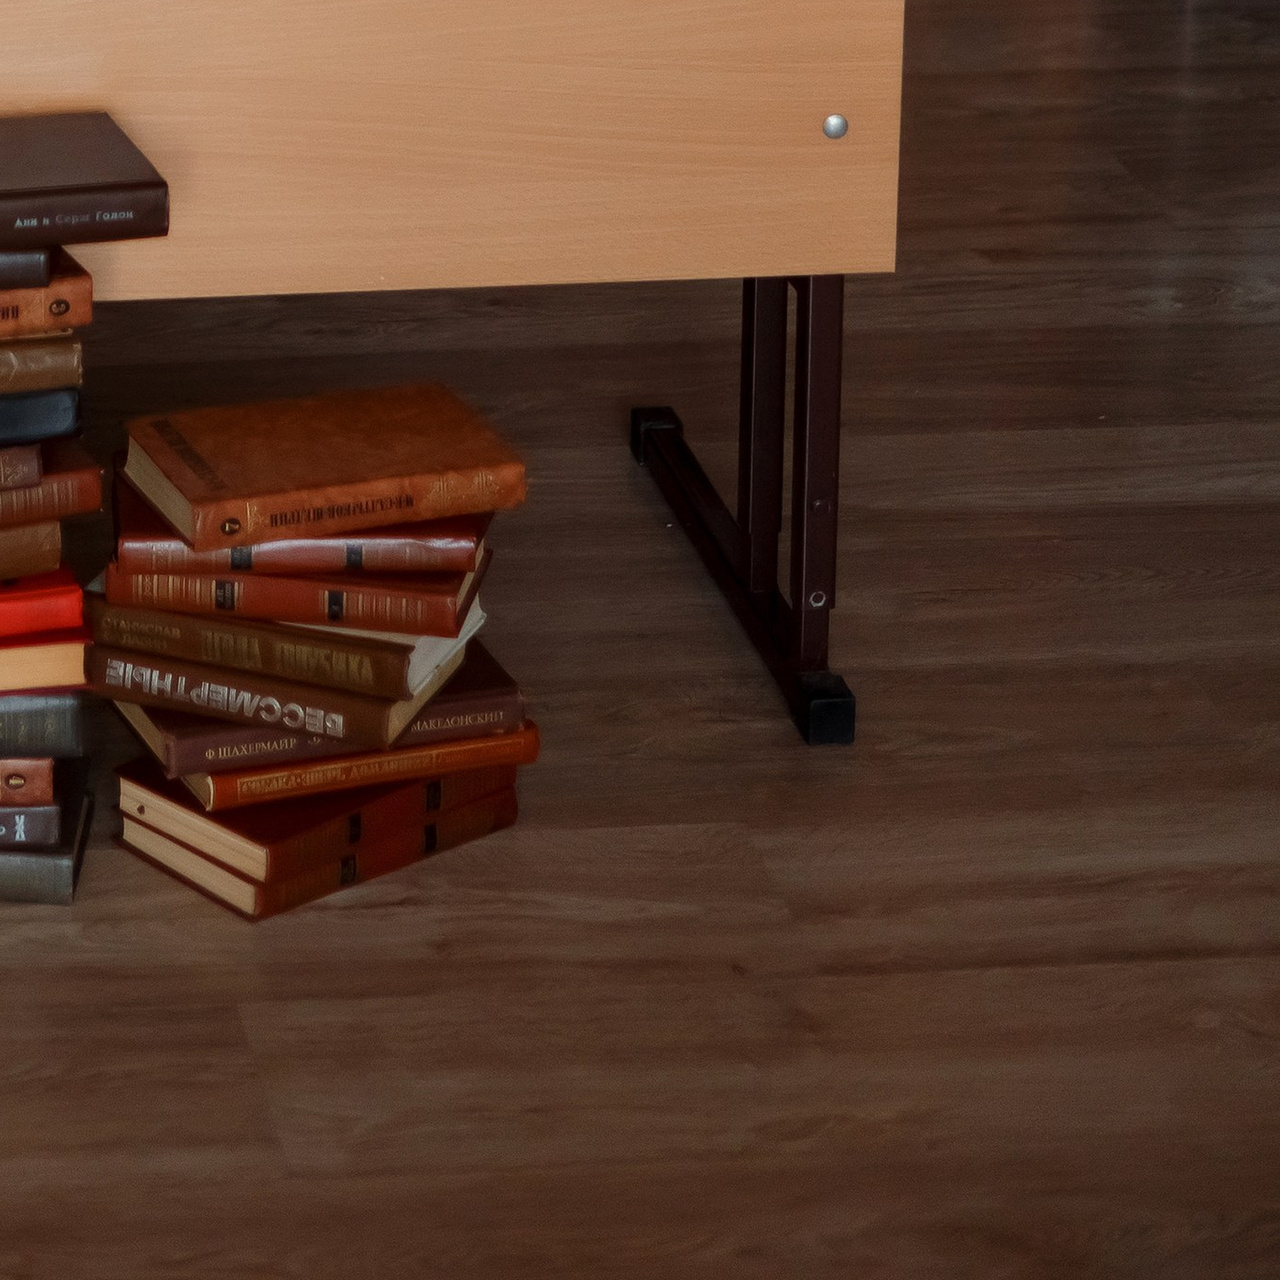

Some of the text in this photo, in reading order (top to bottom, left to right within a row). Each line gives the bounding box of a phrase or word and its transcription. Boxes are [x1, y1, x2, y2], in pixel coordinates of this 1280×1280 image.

[95, 210, 135, 223] Голон
[105, 658, 345, 739] БЕССМЕРТНЫЕ
[410, 710, 506, 732] МАКЕДОНСКИЙ
